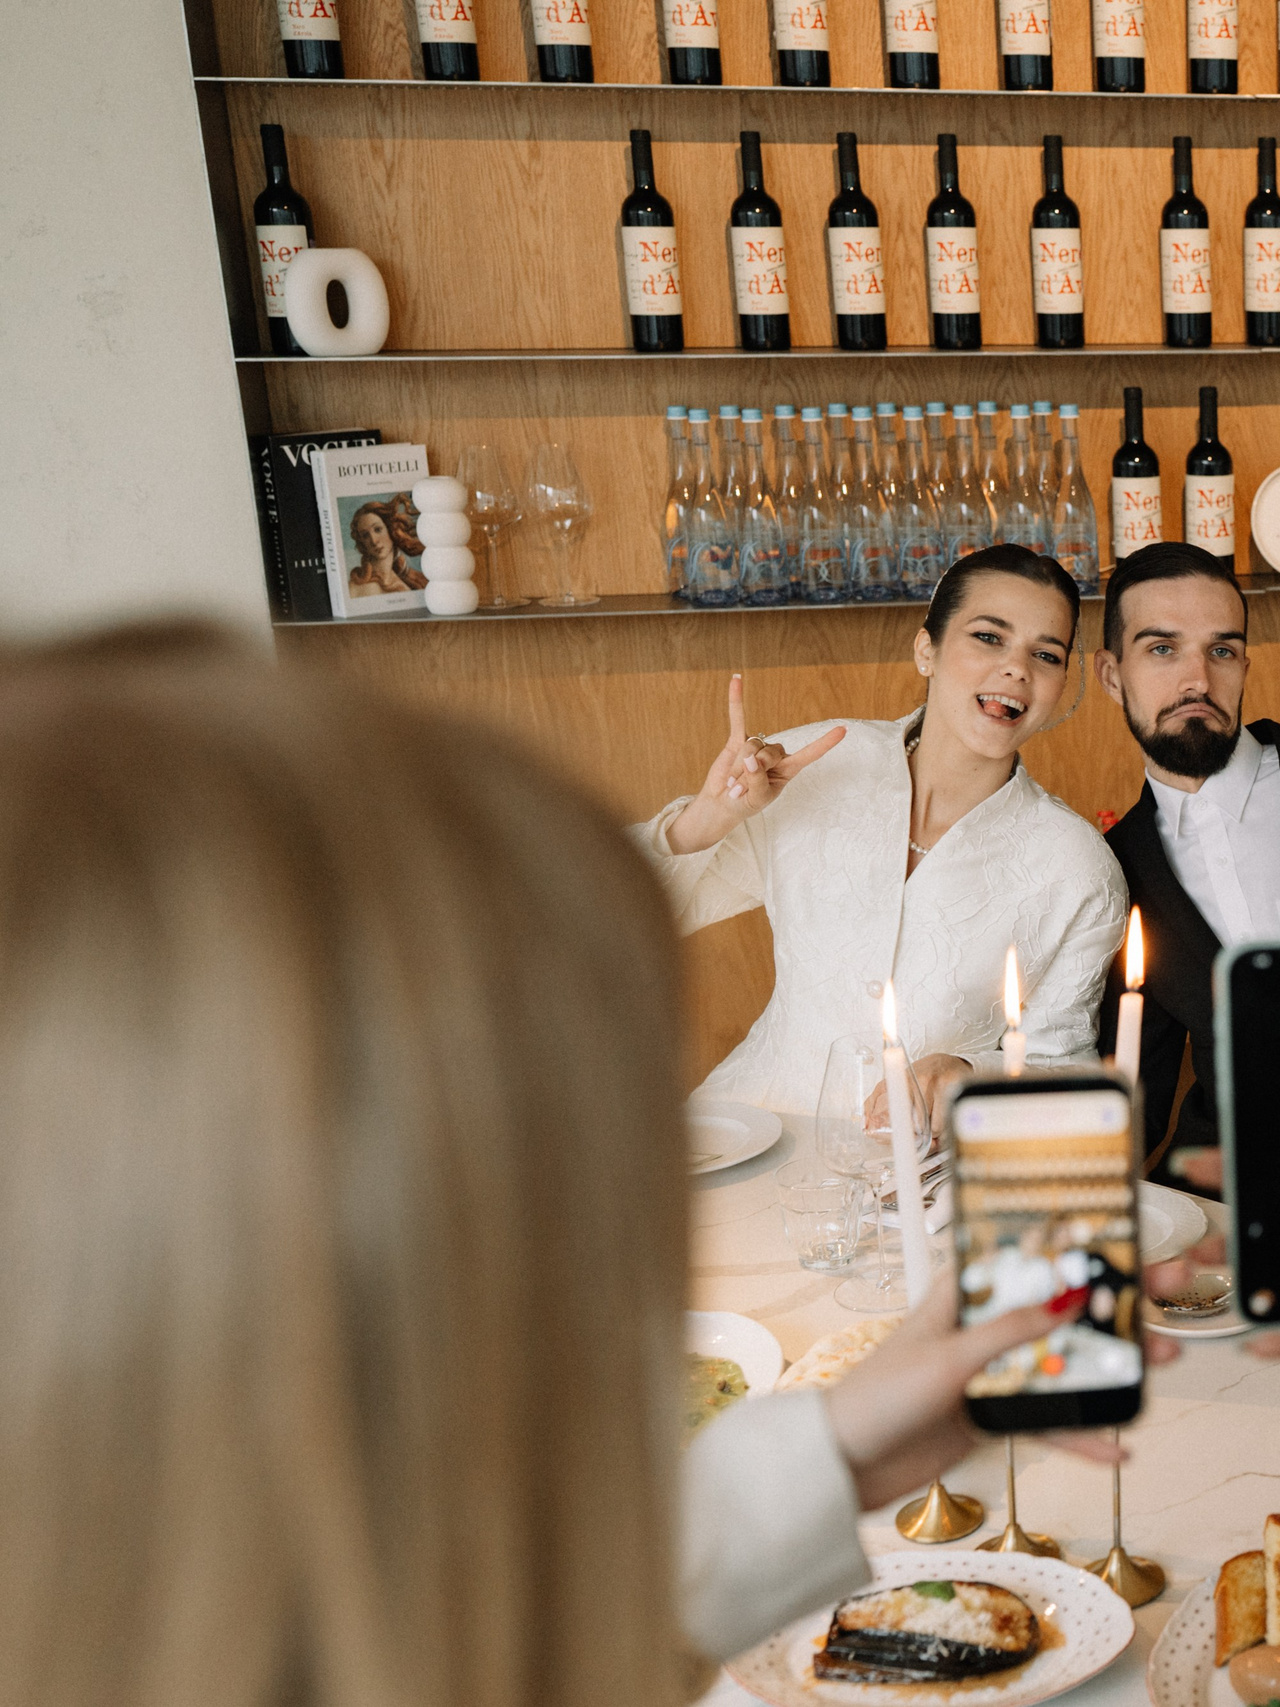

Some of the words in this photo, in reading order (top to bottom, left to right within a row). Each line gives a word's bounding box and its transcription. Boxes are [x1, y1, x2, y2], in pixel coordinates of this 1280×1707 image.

[936, 241, 979, 263] Ner
[1040, 242, 1082, 263] Ner
[337, 459, 419, 478] BOTTICELLI
